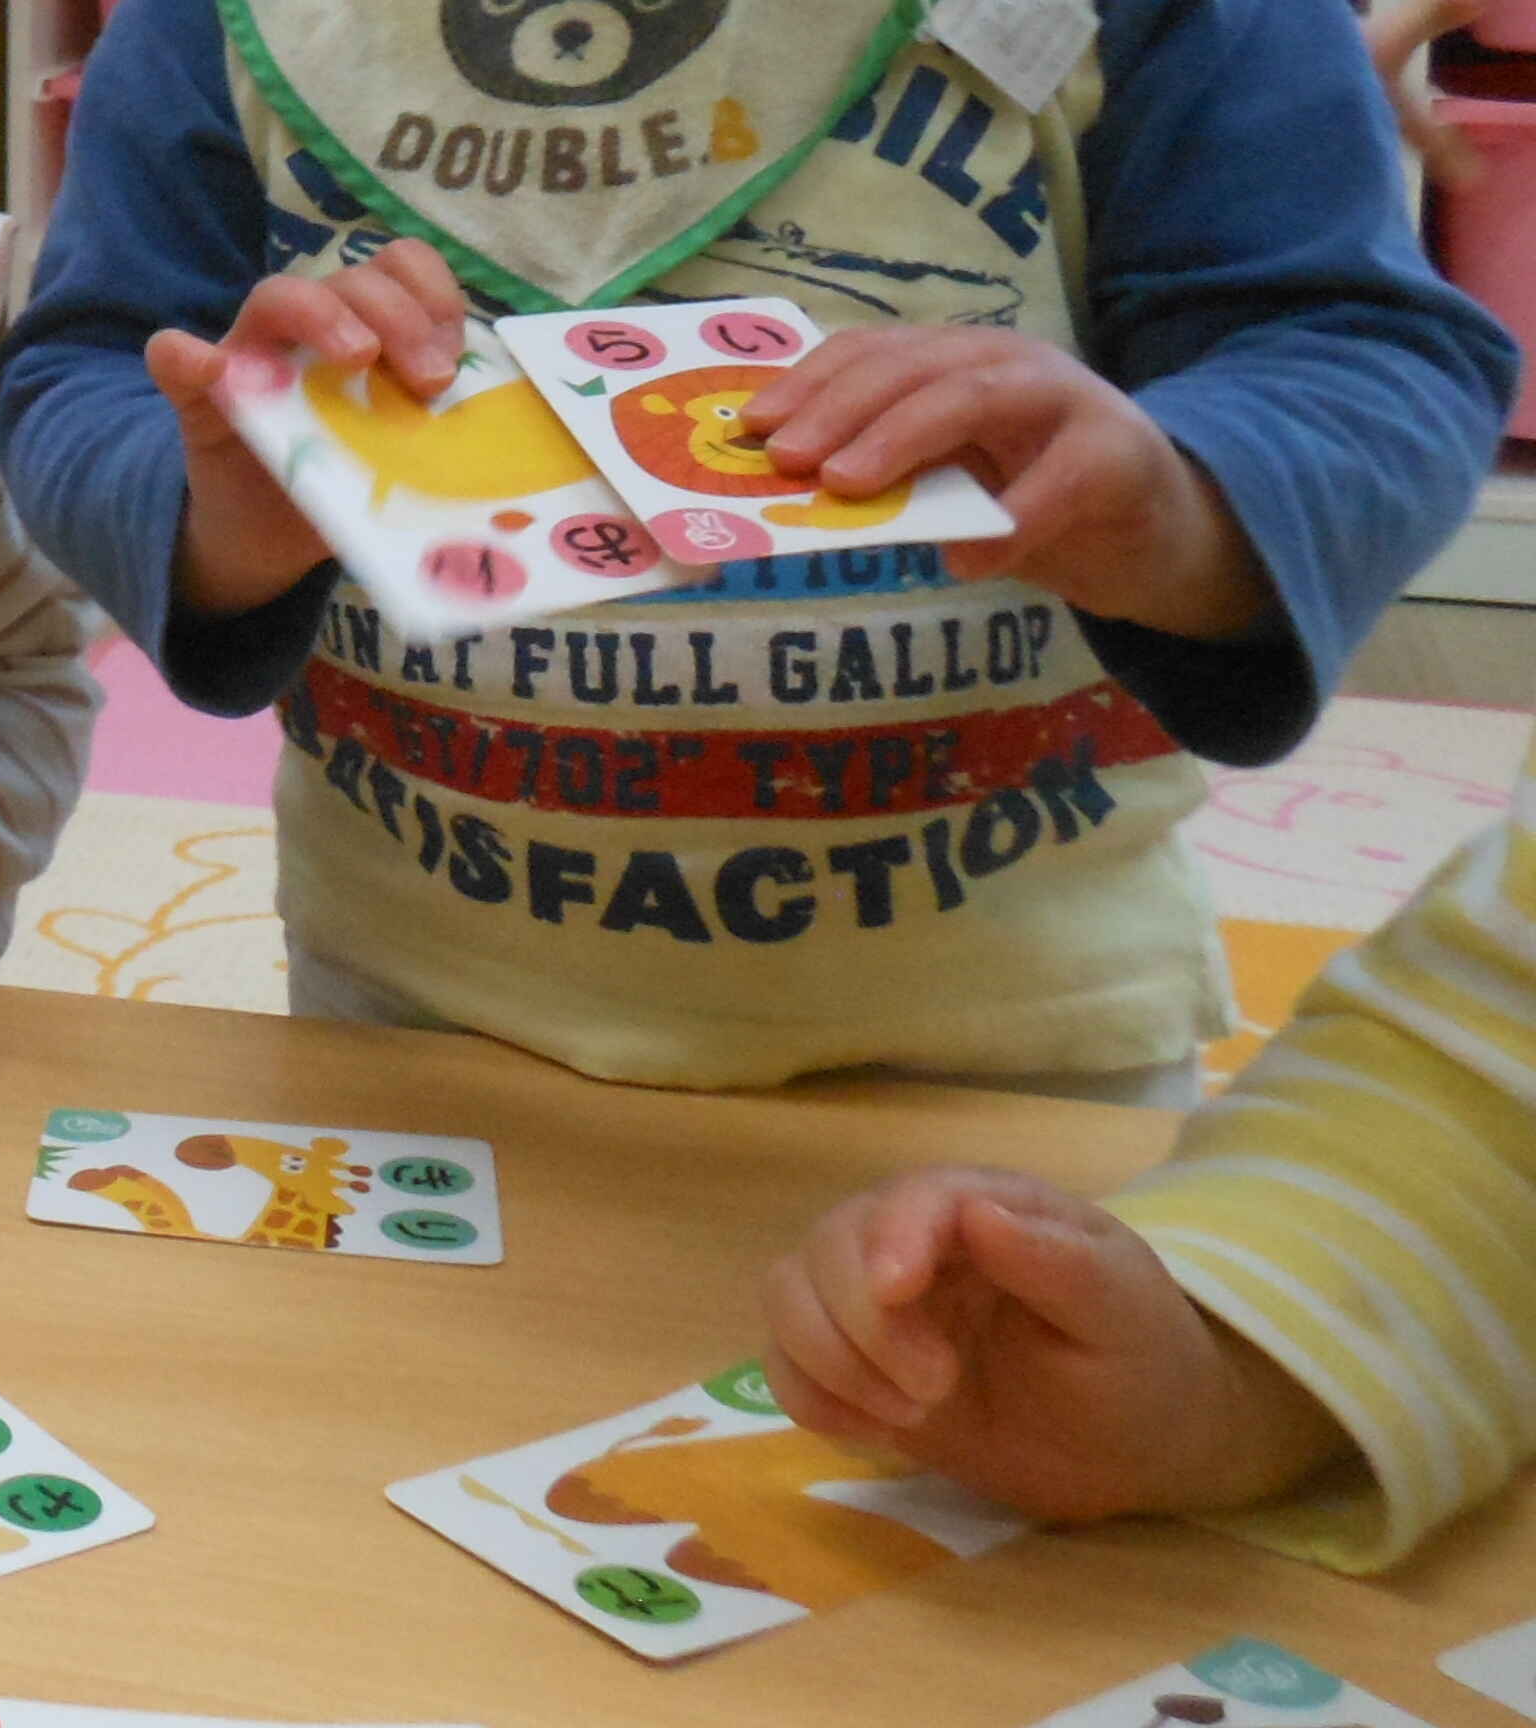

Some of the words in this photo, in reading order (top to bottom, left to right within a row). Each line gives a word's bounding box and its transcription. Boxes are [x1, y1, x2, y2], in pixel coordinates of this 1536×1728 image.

[510, 626, 740, 707] FULL
[768, 603, 1055, 705] GALLOP
[282, 680, 1118, 945] SATISFACTION
[736, 730, 961, 815] TYPE
